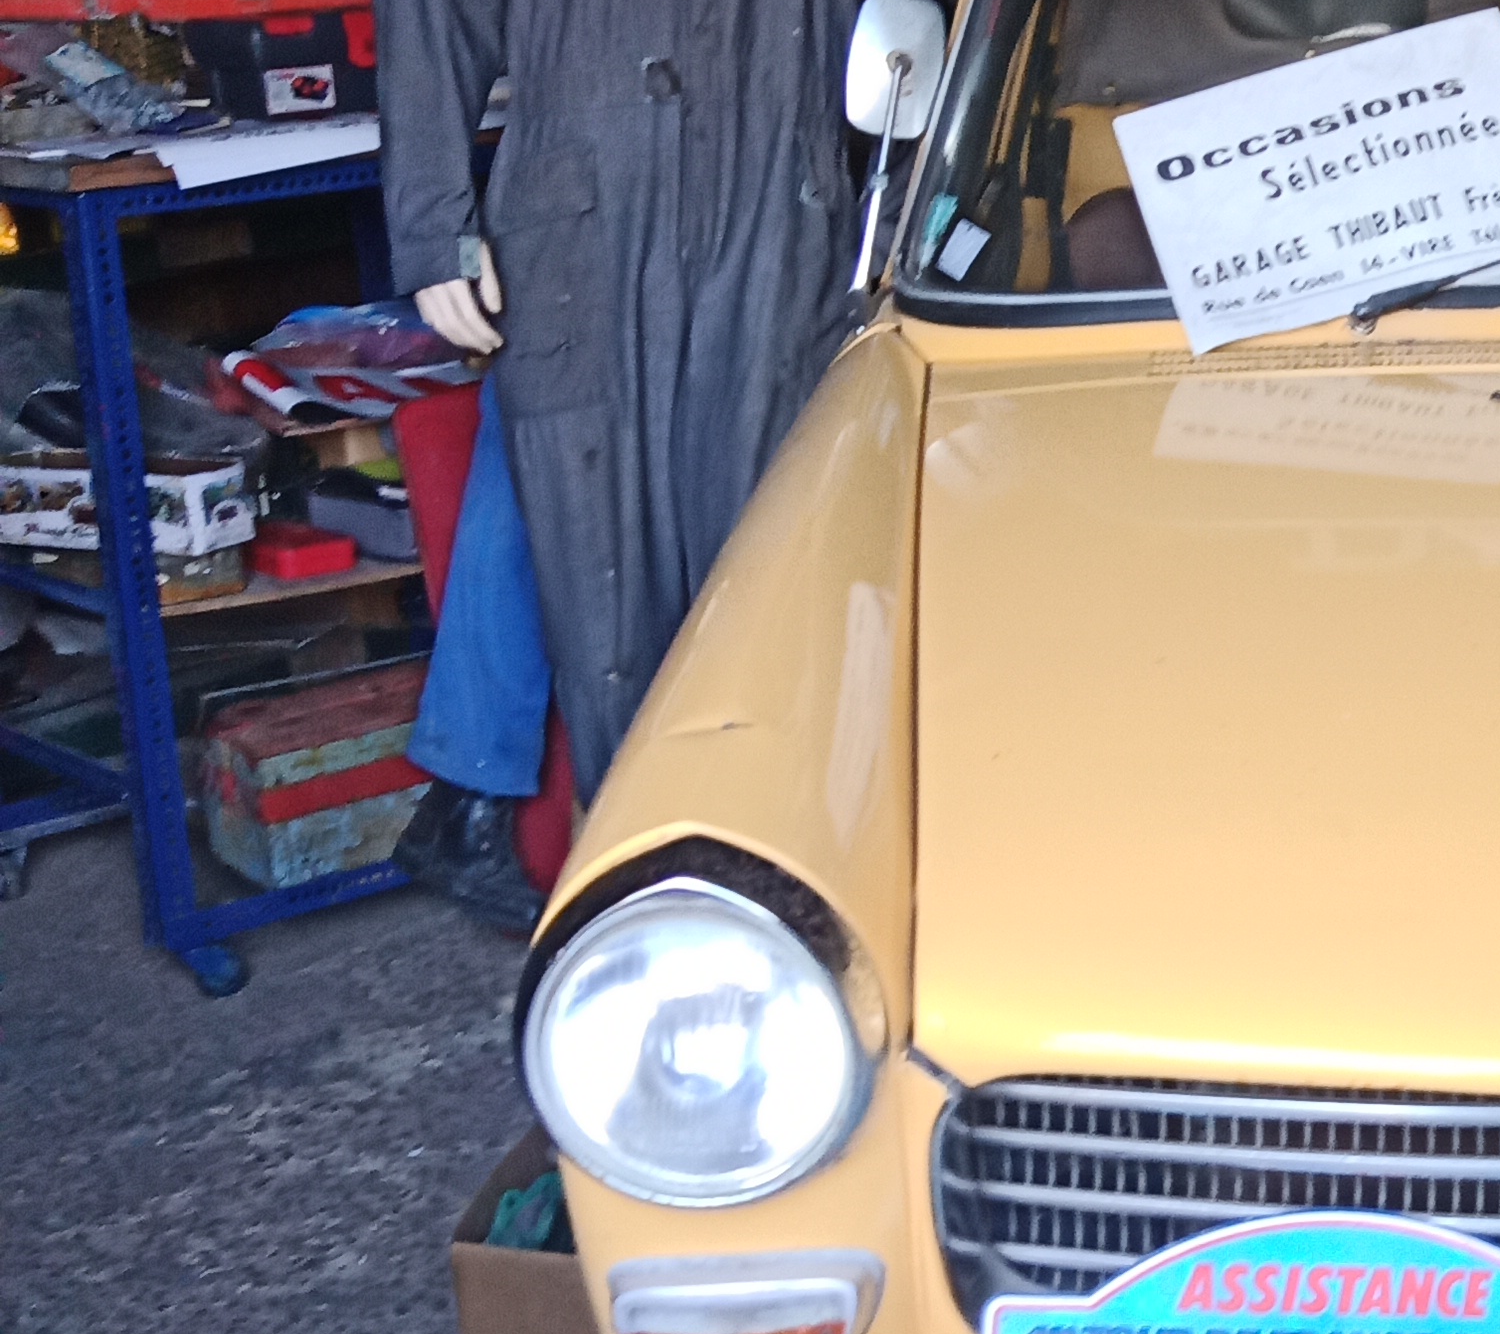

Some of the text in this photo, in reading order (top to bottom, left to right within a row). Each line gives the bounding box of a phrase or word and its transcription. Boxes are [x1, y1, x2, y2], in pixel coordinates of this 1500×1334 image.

[1155, 75, 1467, 184] Occasions
[1190, 233, 1313, 290] GARAGE
[1327, 192, 1446, 257] THIBAUT
[1177, 1260, 1494, 1319] ASSISTANCE
